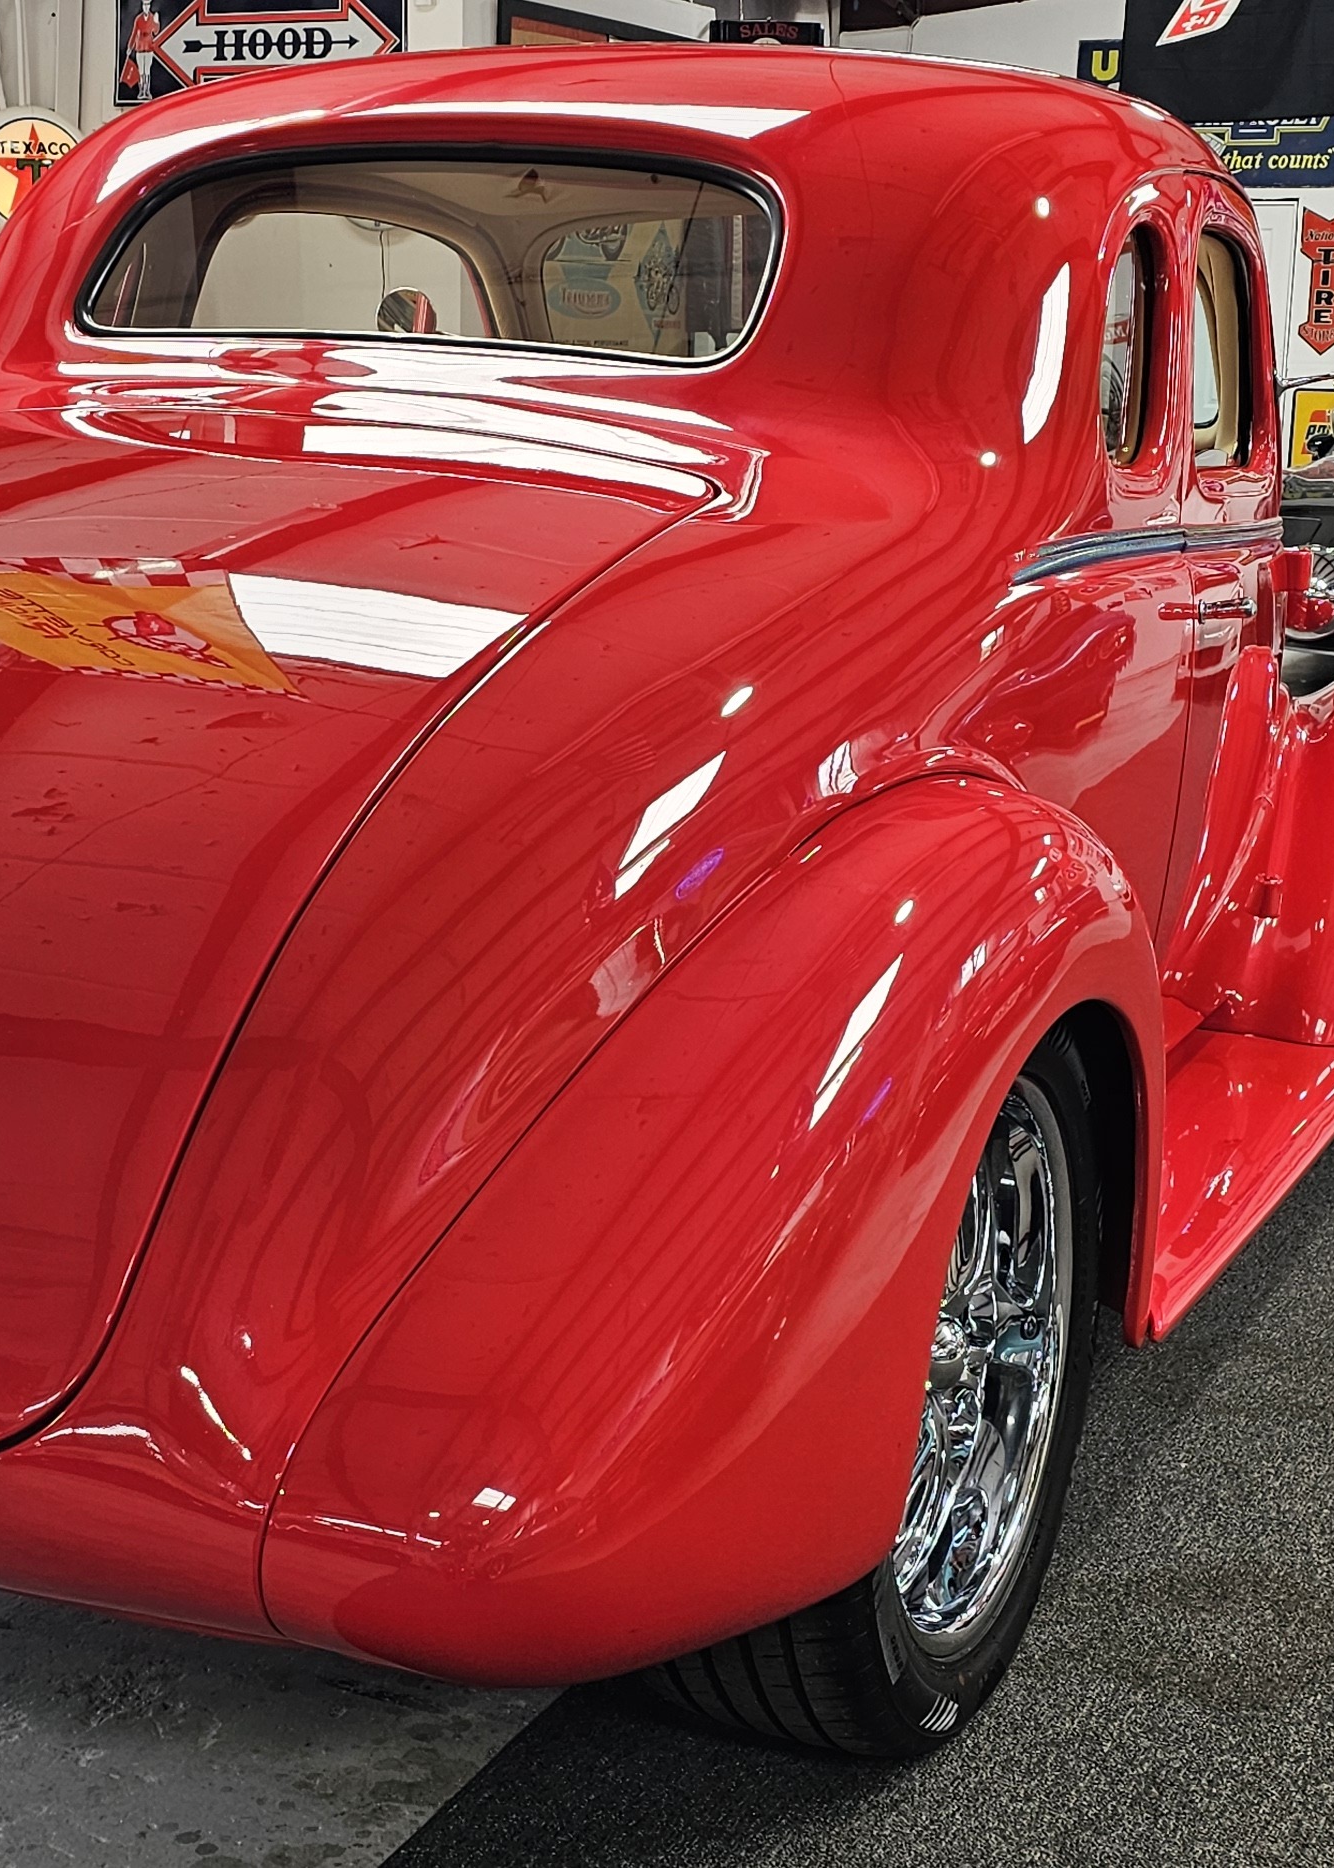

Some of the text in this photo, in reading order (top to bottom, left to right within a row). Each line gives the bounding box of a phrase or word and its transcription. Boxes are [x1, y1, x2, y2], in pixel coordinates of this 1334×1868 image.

[739, 22, 799, 39] SALES
[213, 27, 333, 61] HOOD
[1222, 151, 1263, 172] that
